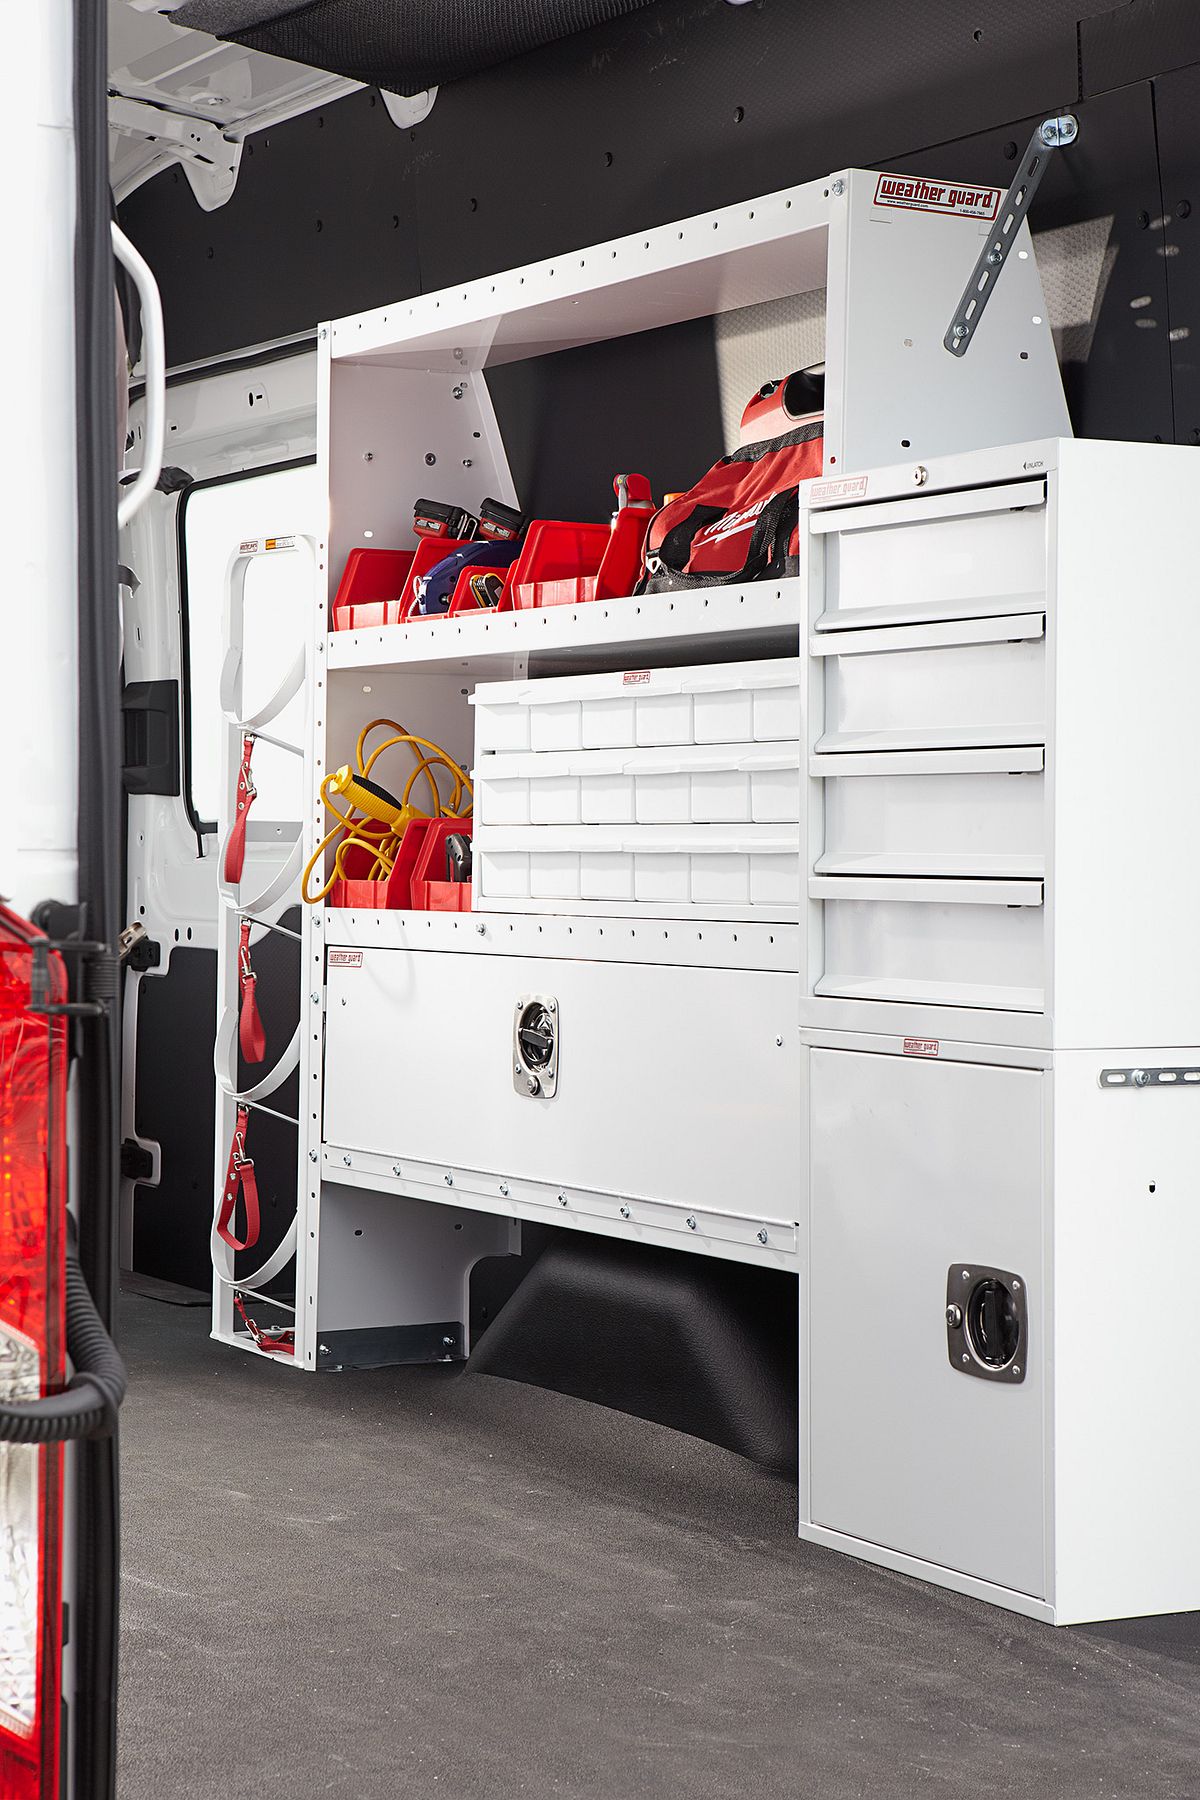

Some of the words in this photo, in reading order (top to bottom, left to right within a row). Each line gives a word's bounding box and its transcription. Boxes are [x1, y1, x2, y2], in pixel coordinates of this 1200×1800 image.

[881, 180, 946, 201] weather
[948, 190, 993, 208] guard
[811, 482, 841, 497] weather
[843, 478, 865, 496] guard
